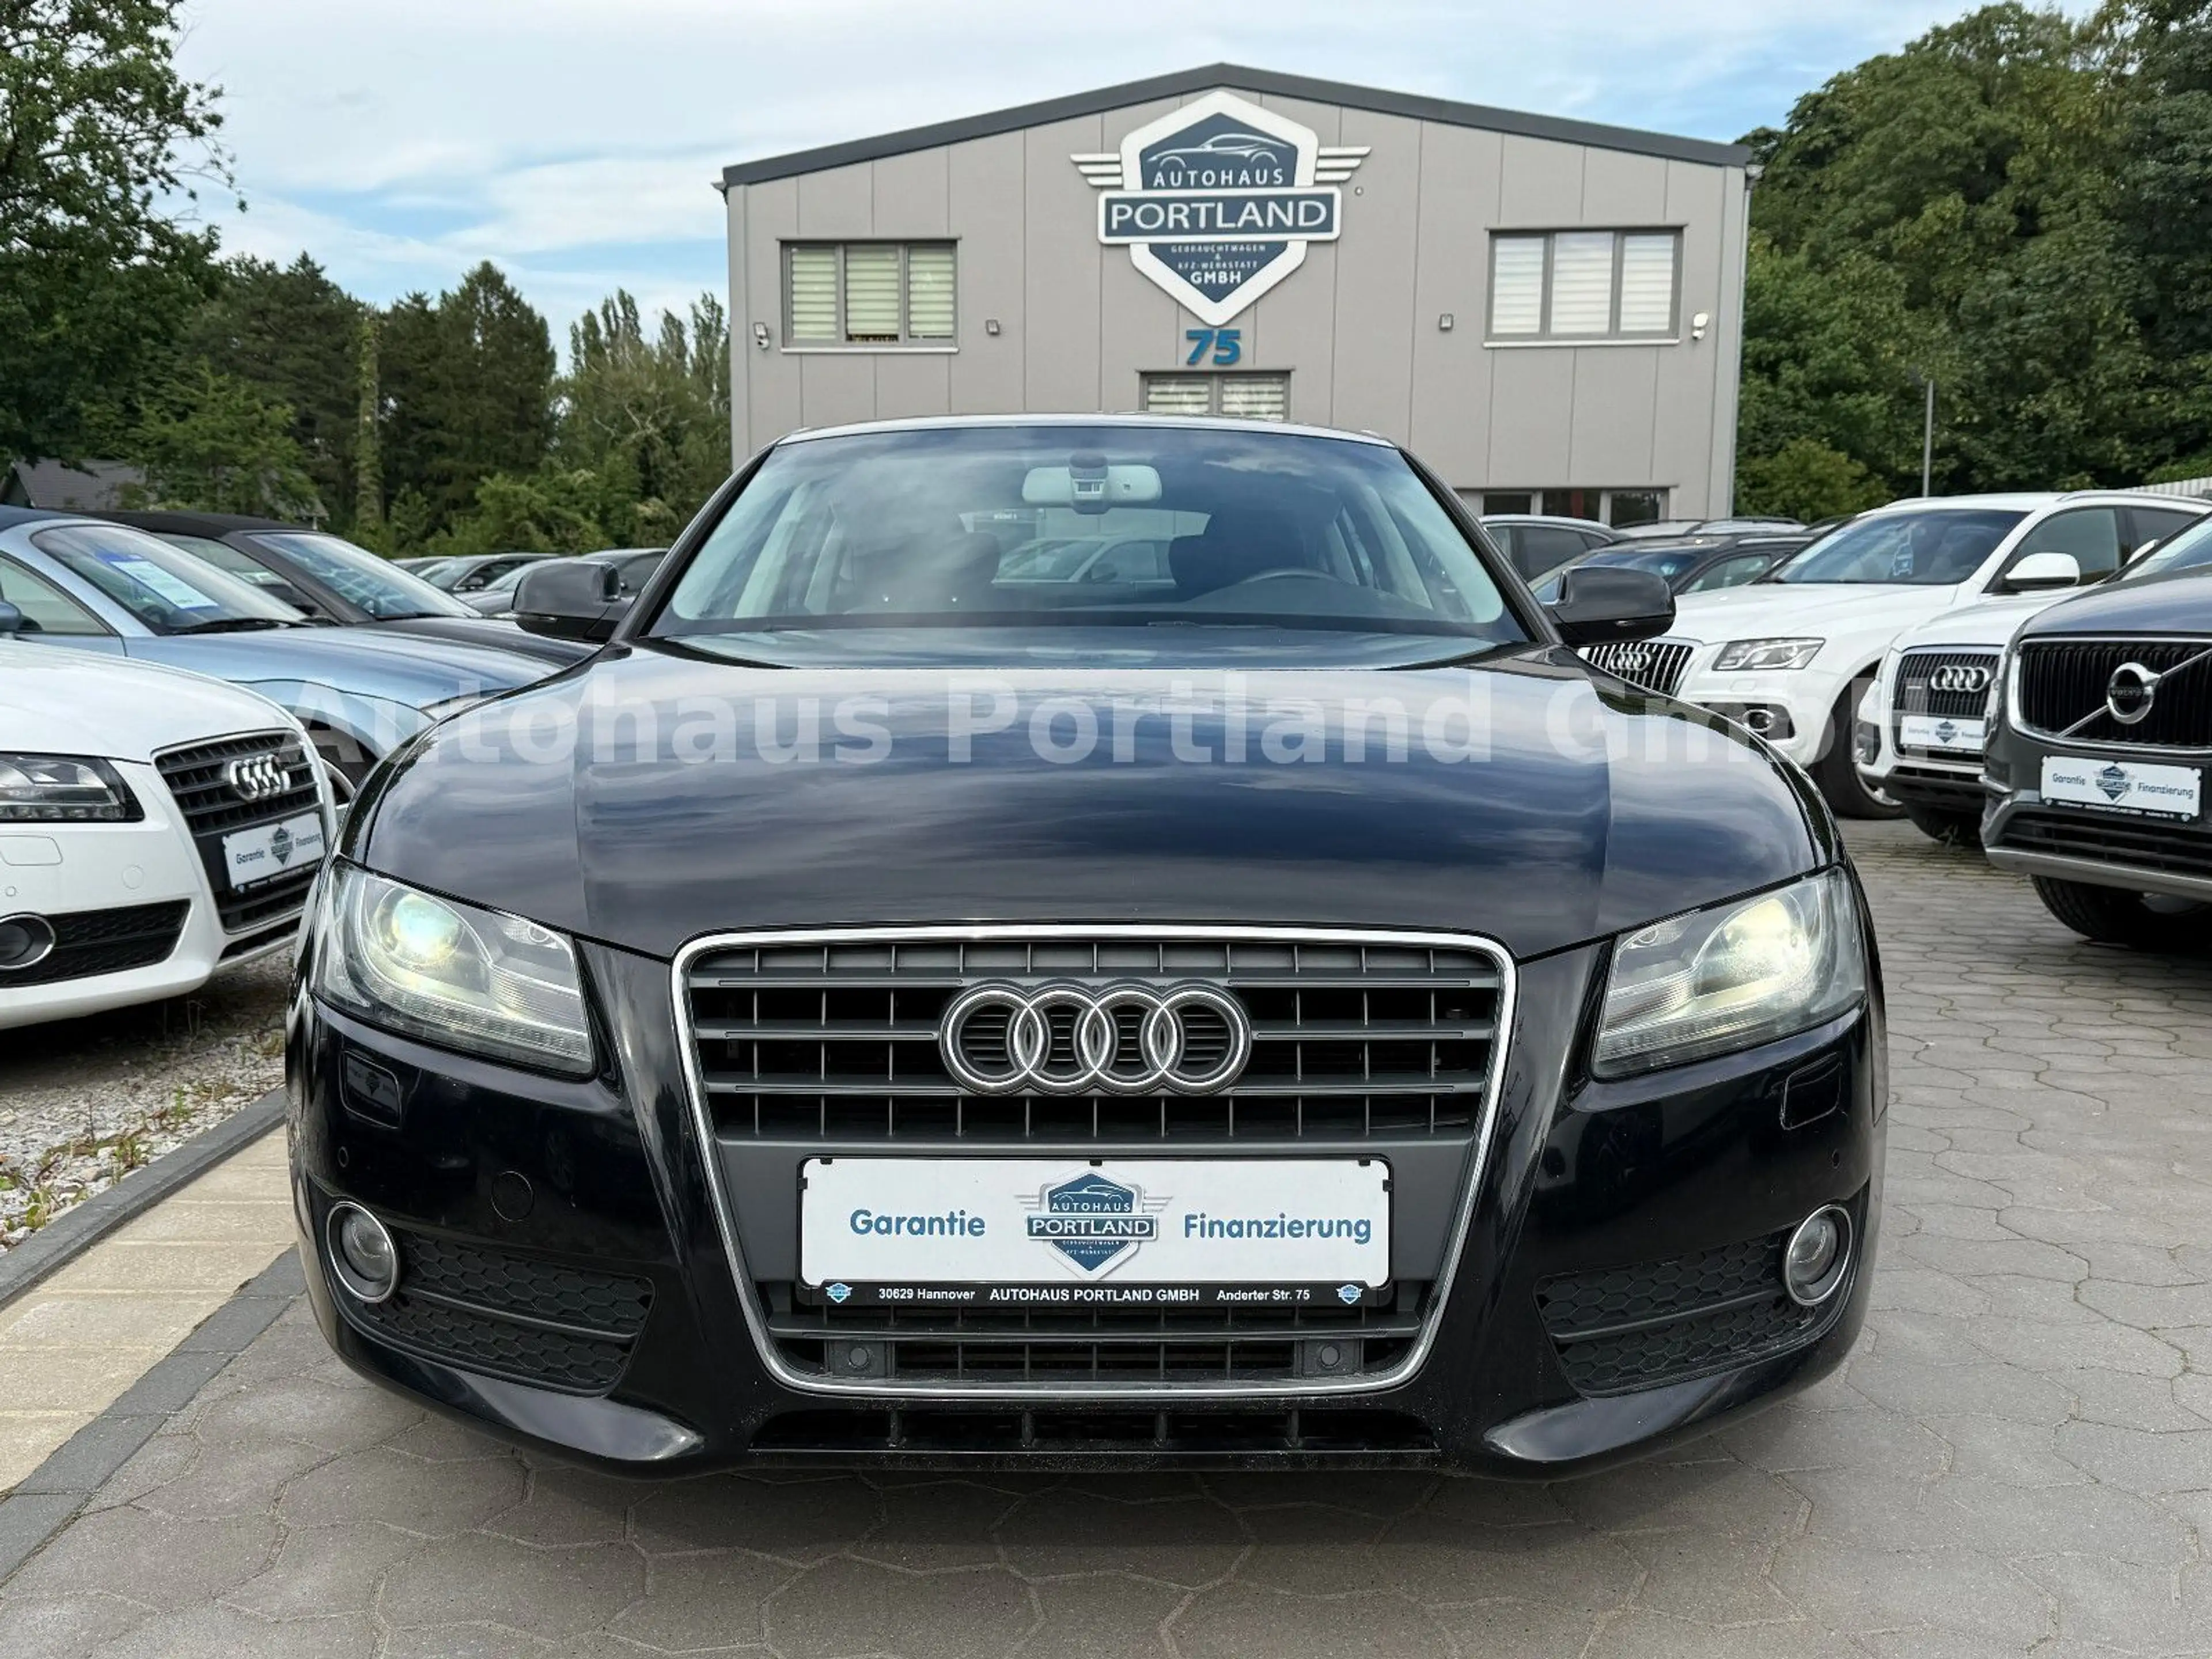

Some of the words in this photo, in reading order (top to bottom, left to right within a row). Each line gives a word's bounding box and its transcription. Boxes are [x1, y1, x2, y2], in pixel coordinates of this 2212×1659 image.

[1153, 168, 1283, 188] AUTOHAUS
[1111, 199, 1327, 230] PORTLAND
[1190, 271, 1241, 285] GMBH
[1185, 328, 1241, 366] 75
[2138, 782, 2194, 800] Finanzierung
[1051, 1202, 1130, 1211] AUTOHAUS
[850, 1209, 986, 1237] Garantie
[1032, 1218, 1150, 1234] PORTLAND
[1184, 1212, 1371, 1245] Finanzierung
[878, 1288, 914, 1300] 30629
[918, 1289, 975, 1301] Hannover
[989, 1288, 1070, 1301] AUTOHAUS
[1074, 1289, 1152, 1302] PORTLAND
[1156, 1289, 1199, 1302] GMBH
[1217, 1289, 1270, 1301] Anderter
[1272, 1289, 1293, 1301] Str.
[1296, 1290, 1310, 1301] 75
